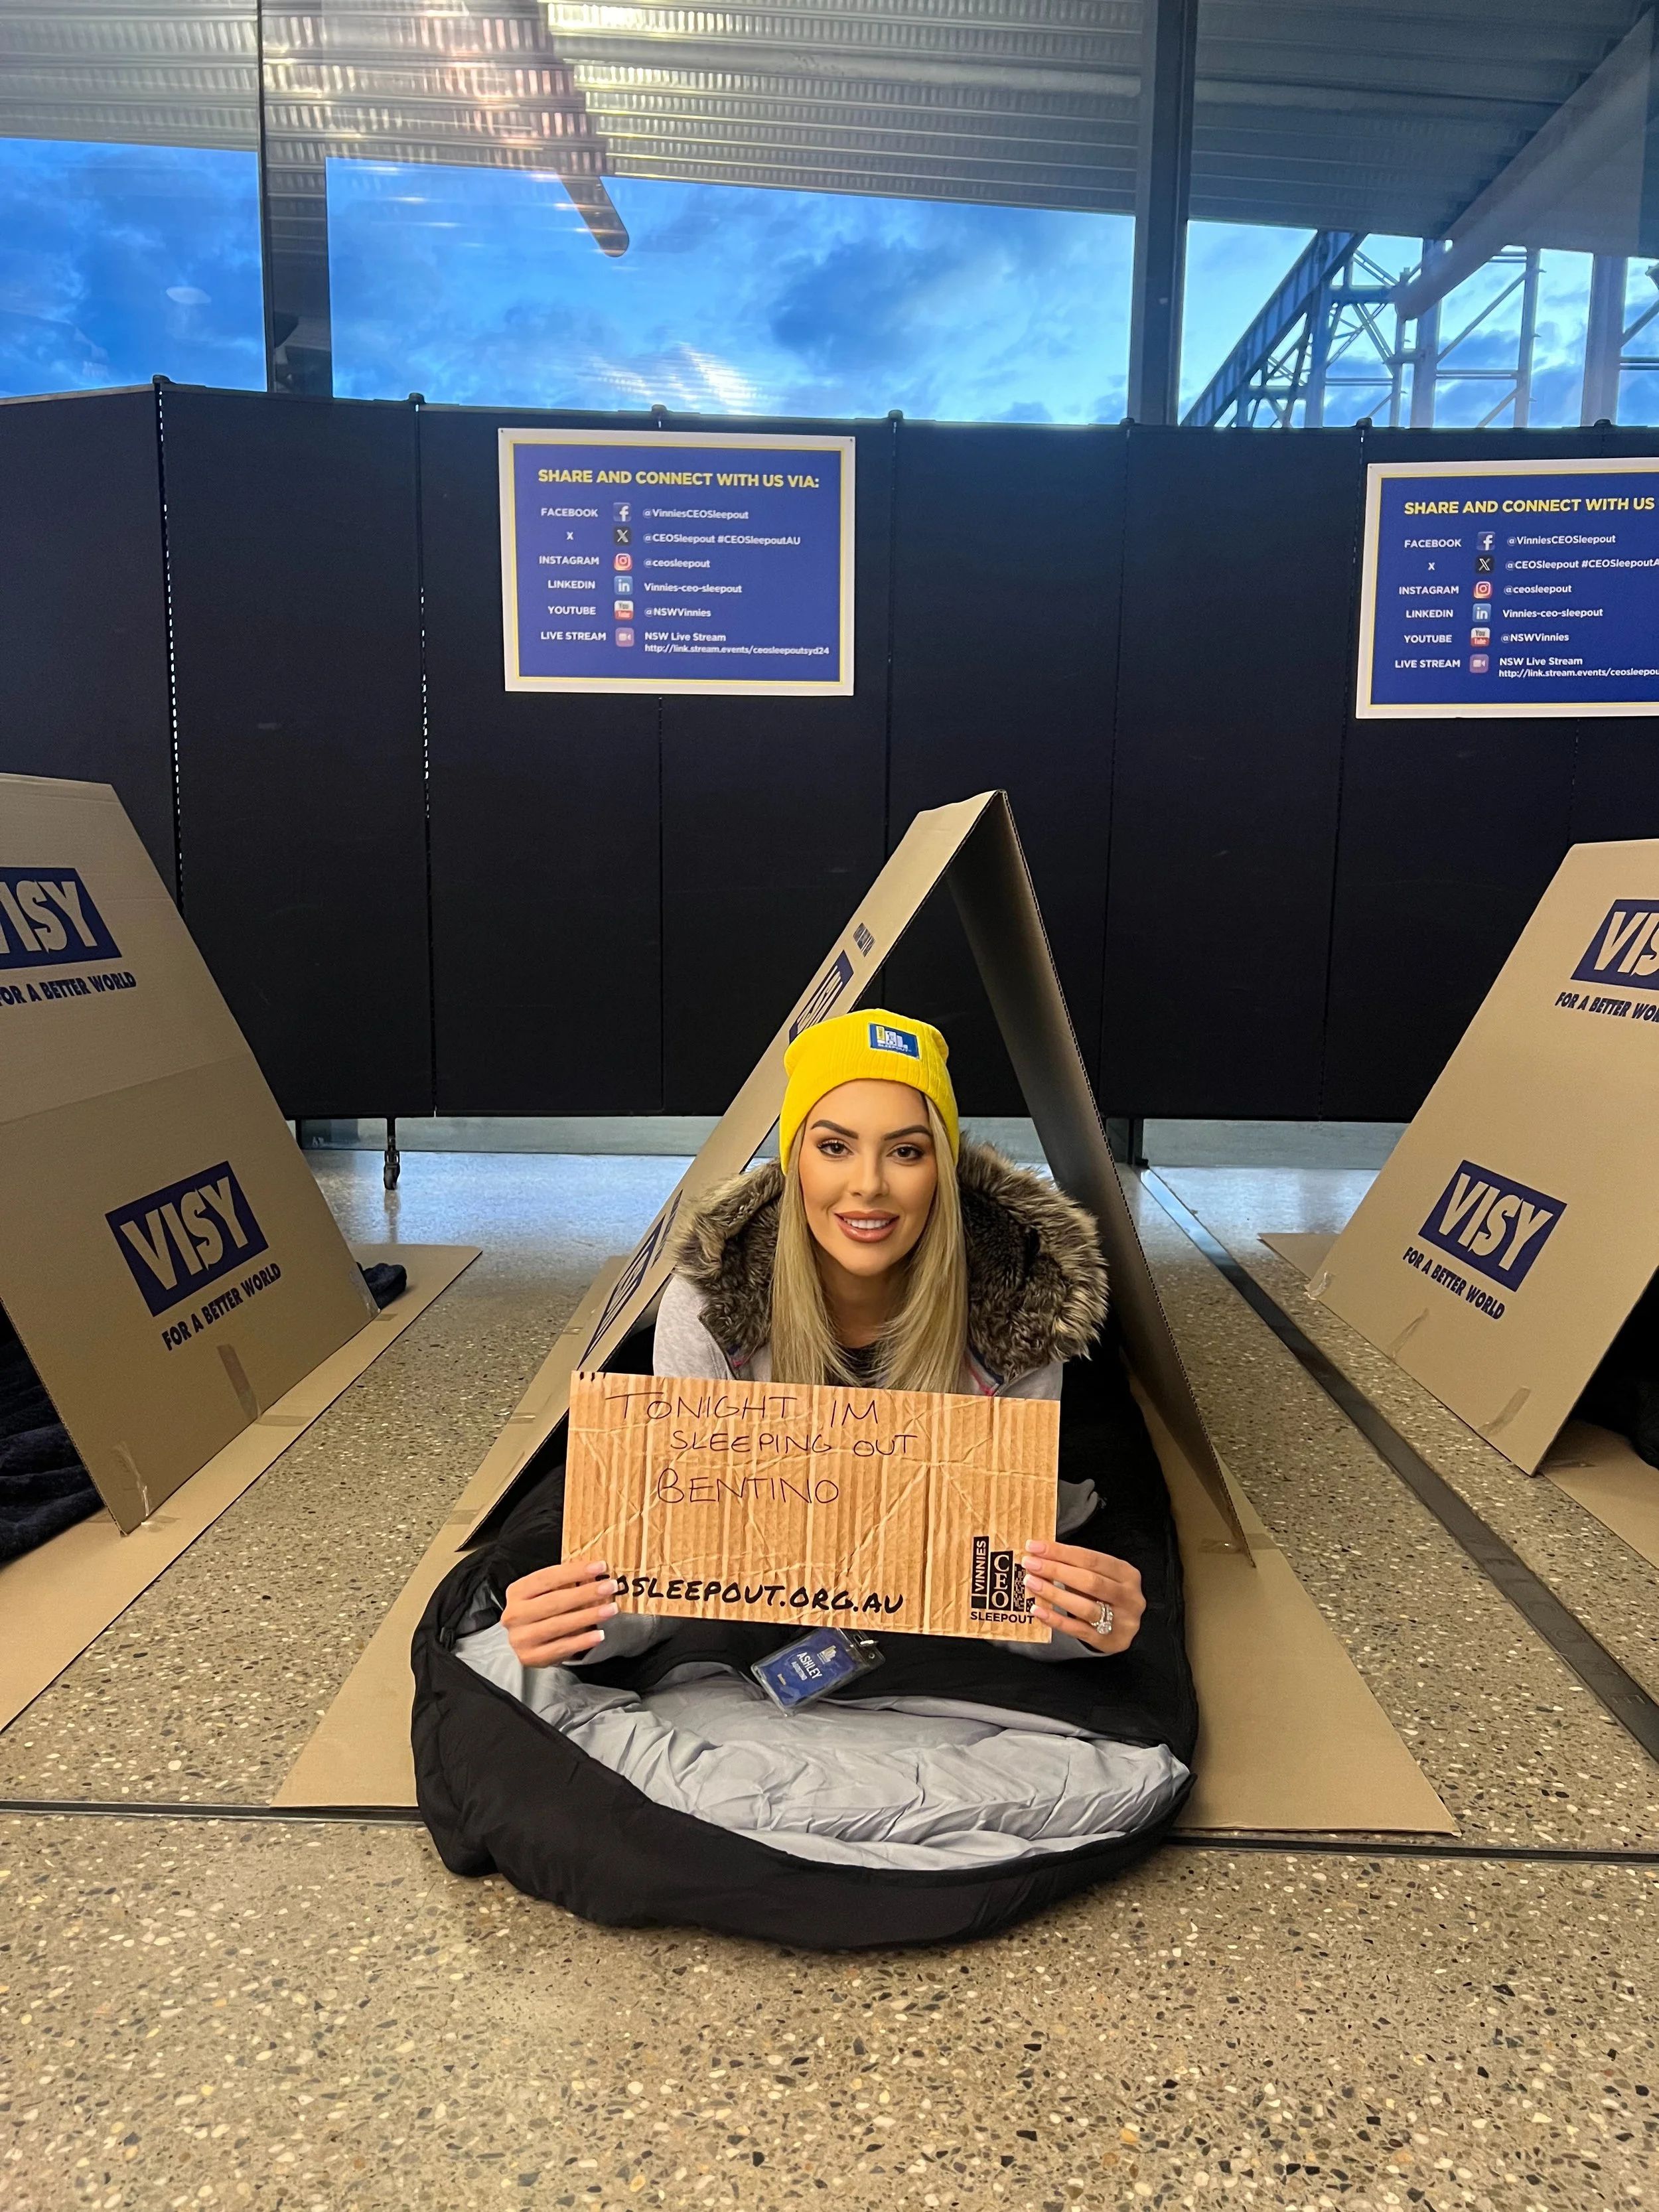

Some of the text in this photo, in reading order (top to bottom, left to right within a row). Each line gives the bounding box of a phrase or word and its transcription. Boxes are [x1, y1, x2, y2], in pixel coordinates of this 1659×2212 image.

[538, 469, 820, 488] SHARE AND CONNECT WITH US VIA:
[1404, 497, 1655, 515] SHARE AND CONNECT WITH US
[541, 508, 599, 518] FACEBOOK
[642, 508, 749, 520] @VinniesCEOSleepout
[566, 532, 574, 540] X
[643, 534, 801, 546] @CEOSleepout #CEOSleepoutAU
[1507, 535, 1617, 547] @VinniesCEOSleepout
[1404, 539, 1462, 548] FACEBOOK
[539, 555, 599, 565] INSTAGRAM
[644, 558, 711, 569] @ceosleepout
[1505, 559, 1579, 571] @CEOSleepout
[1428, 562, 1435, 571] X
[547, 580, 595, 589] LINKEDIN
[644, 583, 742, 595] Vinnies-ceo-sleepout
[1399, 586, 1459, 595] INSTAGRAM
[1504, 585, 1572, 595] @ceosleepout
[547, 606, 597, 615] YOUTUBE
[644, 608, 711, 618] @NSWVinnies
[1406, 609, 1454, 619] LINKEDIN
[1502, 609, 1604, 619] Vinnies-ceo-sleepout
[541, 632, 607, 640] LIVE STREAM
[645, 632, 727, 642] NSW Live Stream
[1404, 634, 1453, 644] YOUTUBE
[1501, 632, 1569, 644] @NSWVinnies
[1395, 659, 1460, 668] LIVE STREAM
[1499, 656, 1583, 666] NSW Live Stream
[0, 880, 98, 954] ISY
[0, 972, 137, 1006] OR A BETTER WORLD
[1555, 992, 1579, 1009] FOR
[1577, 995, 1590, 1011] A
[1589, 997, 1632, 1017] BETTER
[1438, 1172, 1554, 1272] VISY
[119, 1176, 249, 1291] VISY
[1403, 1246, 1505, 1320] FOR A BETTER WORLD
[161, 1262, 281, 1351] FOR A BETTER WORLD
[605, 1392, 879, 1428] TONIGHT IM
[670, 1430, 918, 1457] SLEEPING OUT
[657, 1467, 839, 1505] BENTINO
[974, 1540, 987, 1592] VINNIES
[991, 1554, 1010, 1609] CEO
[970, 1611, 1035, 1625] SLEEPOUT
[797, 1652, 823, 1680] ASHLEY
